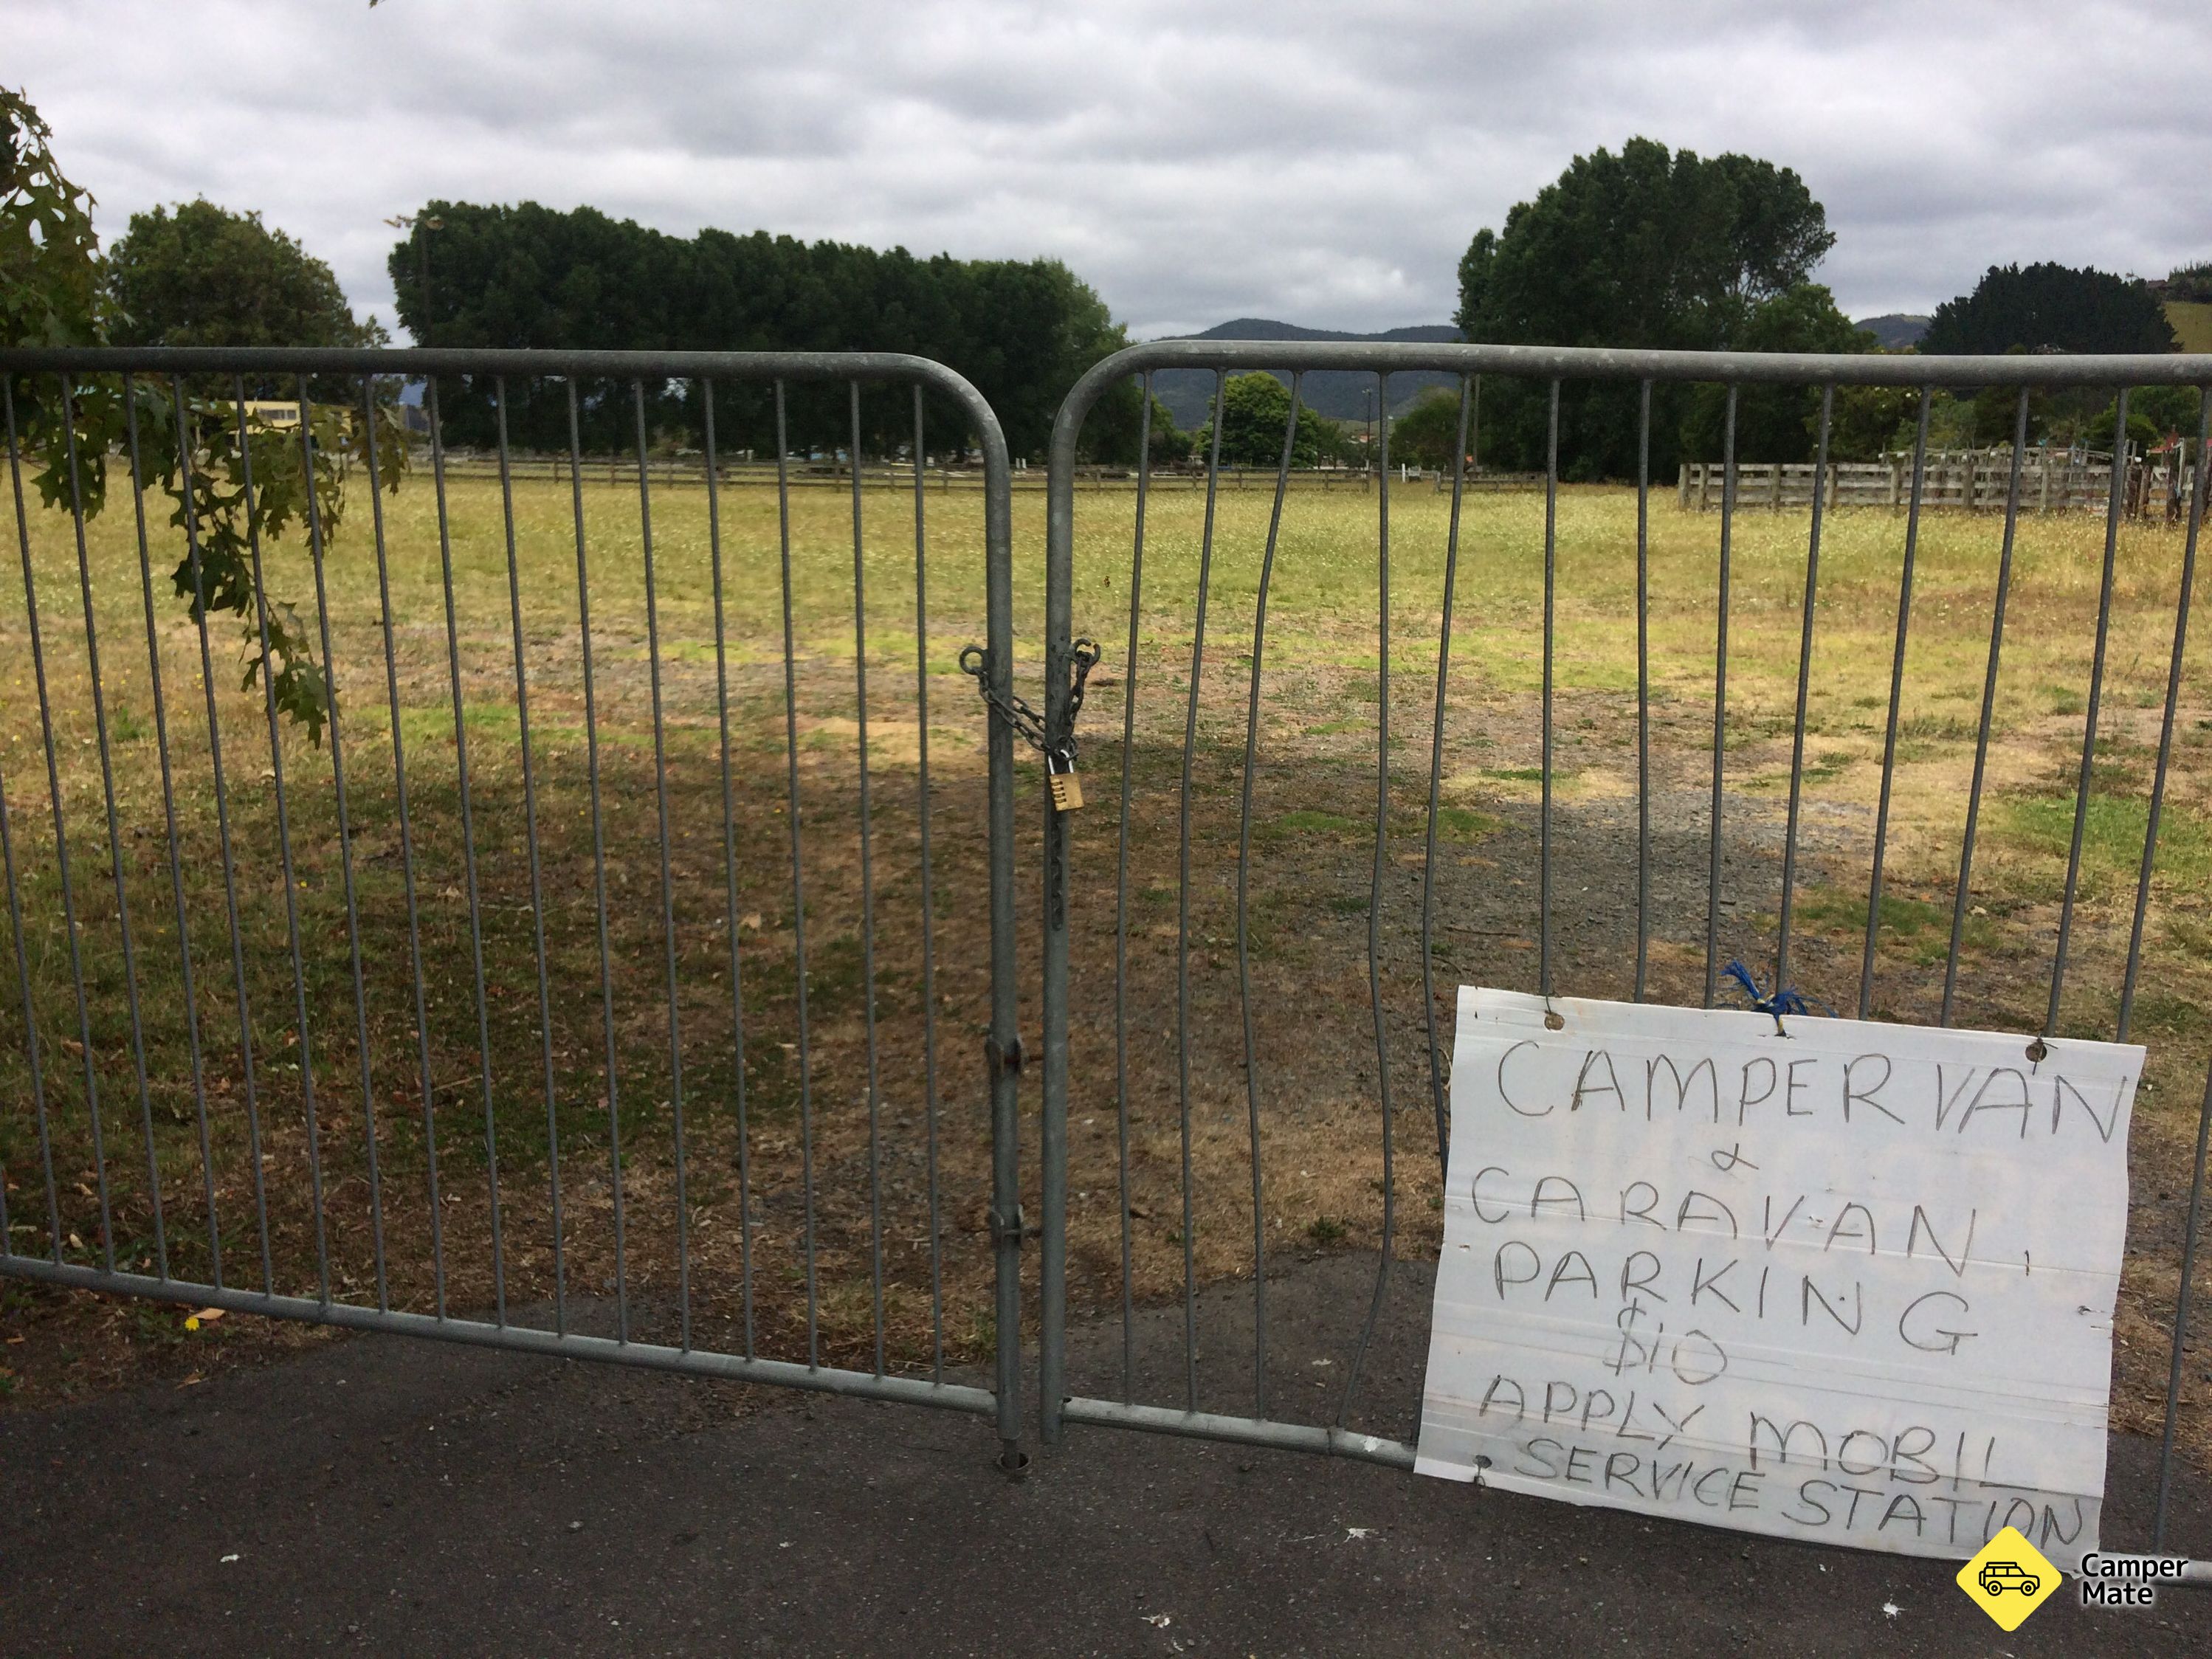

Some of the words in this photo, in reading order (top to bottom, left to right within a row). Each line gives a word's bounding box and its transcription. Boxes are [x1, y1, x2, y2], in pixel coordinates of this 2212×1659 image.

[1471, 1167, 1977, 1276] CARAVAN
[1494, 1241, 1979, 1356] PARKING
[1602, 1297, 1728, 1385] $10
[1478, 1374, 1706, 1451] APPLY
[1749, 1410, 2039, 1492] MOBIL
[1514, 1438, 1765, 1511] SERVICE
[1781, 1479, 2084, 1548] STATION
